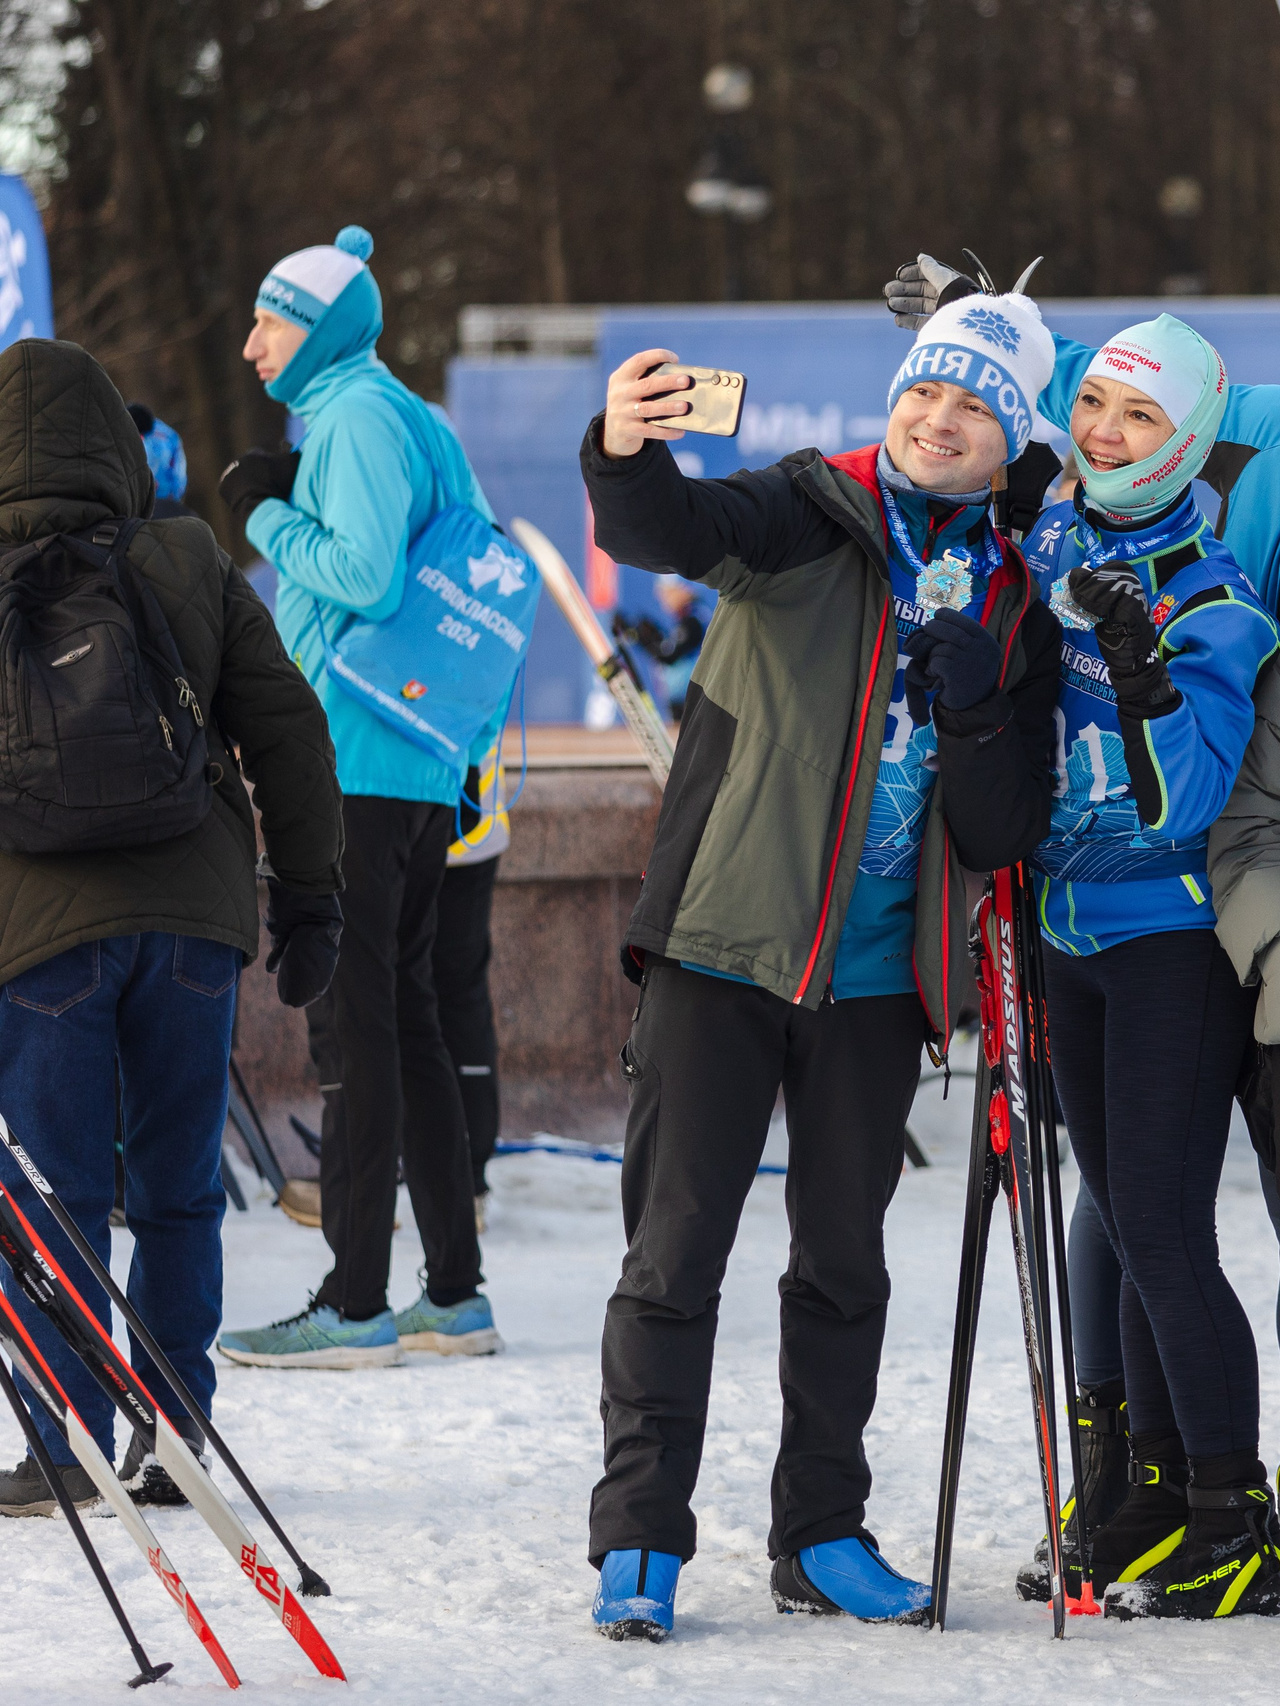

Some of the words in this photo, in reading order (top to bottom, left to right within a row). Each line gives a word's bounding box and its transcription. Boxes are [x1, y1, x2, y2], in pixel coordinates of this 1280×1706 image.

[1105, 356, 1136, 373] парк
[1132, 433, 1197, 489] Муринский
[1157, 456, 1185, 482] парк
[416, 564, 527, 654] ПЕРВОКЛАССНИК
[1053, 603, 1063, 612] 19
[436, 613, 482, 651] 2024
[1000, 917, 1026, 1123] MADSHUS
[14, 1145, 47, 1187] SPORT
[32, 1250, 58, 1281] DELTA
[102, 1362, 129, 1392] COMP
[124, 1392, 155, 1426] DELTA
[1165, 1559, 1242, 1595] FISCHER
[284, 1611, 294, 1629] 173
